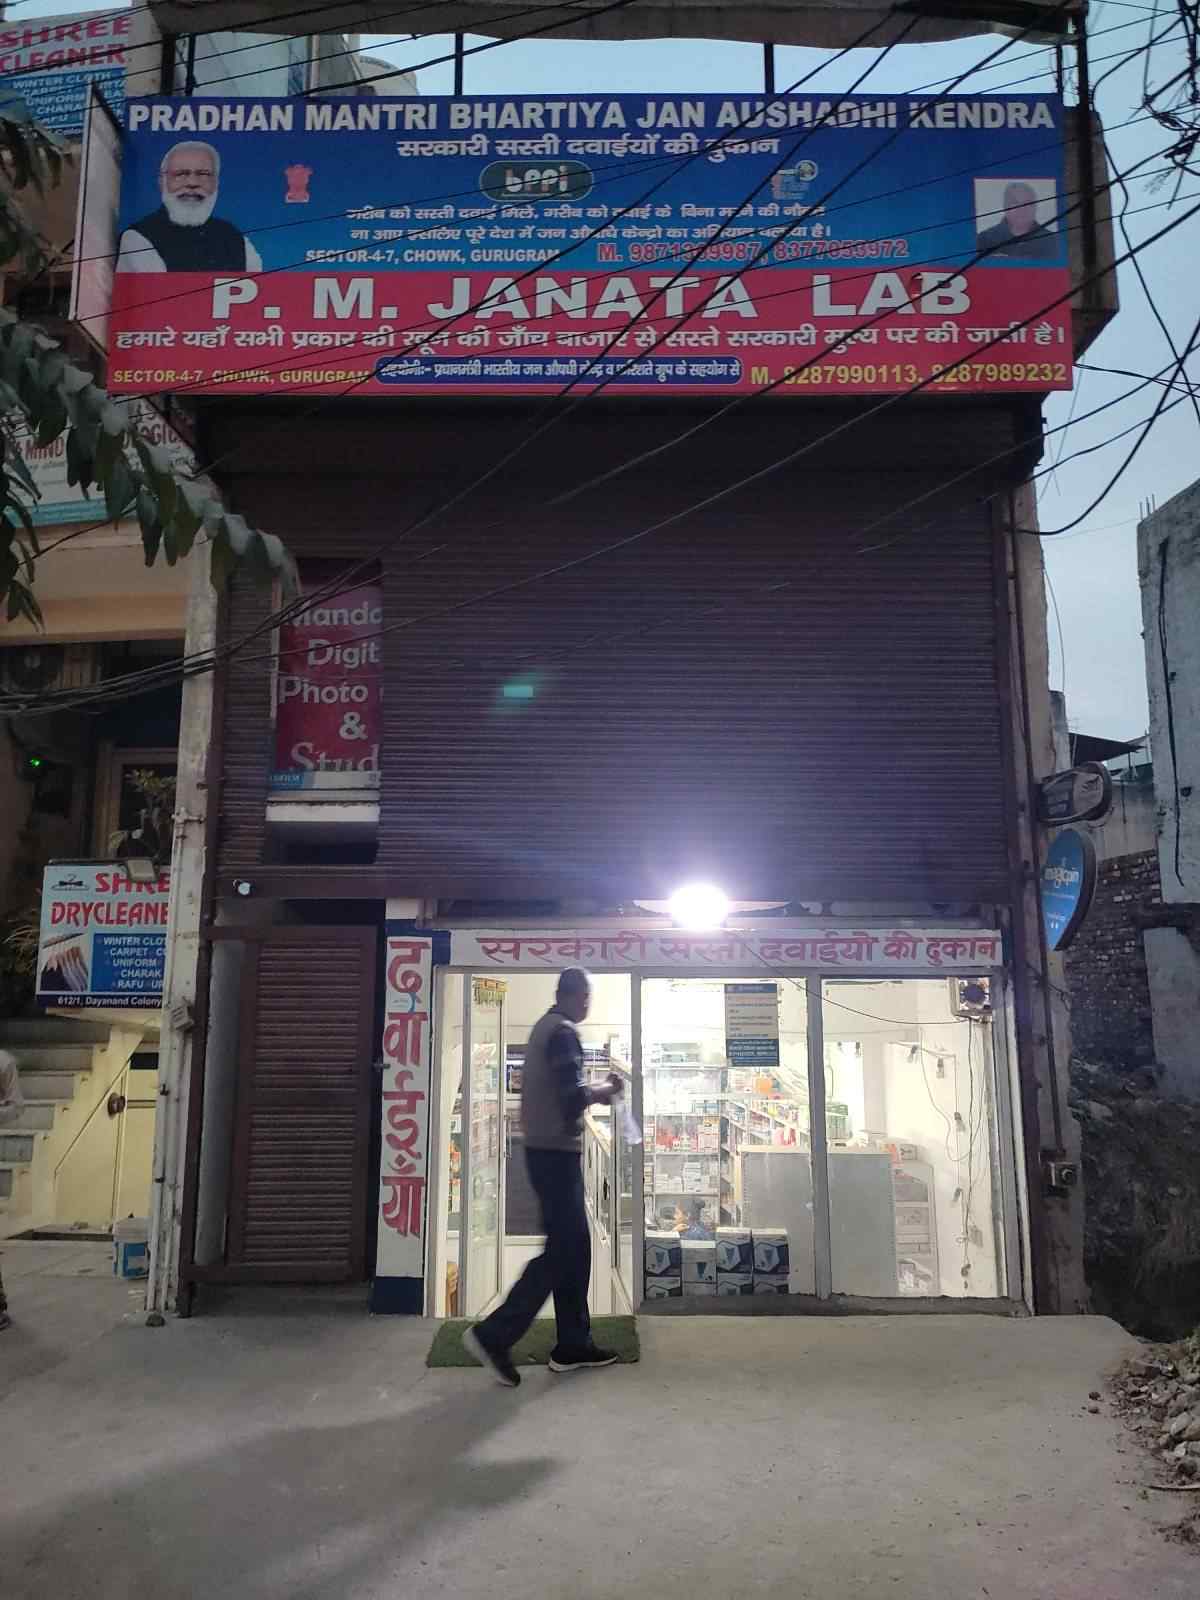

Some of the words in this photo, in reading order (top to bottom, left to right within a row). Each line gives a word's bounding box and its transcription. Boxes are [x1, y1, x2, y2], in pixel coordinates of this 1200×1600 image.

[129, 103, 293, 132] PRADHAN
[305, 102, 437, 131] MANTRI
[450, 102, 626, 129] BHARTIYA
[636, 101, 705, 129] JAN
[715, 101, 897, 129] AUSHADHI
[909, 101, 1056, 129] KENDRA
[397, 133, 490, 157] सरकारी
[496, 132, 561, 157] सस्ती
[663, 131, 699, 156] की
[704, 137, 780, 163] दुकान
[389, 205, 410, 219] को
[414, 204, 455, 220] सस्ती
[543, 204, 584, 219] गरीब
[587, 203, 608, 219] को
[655, 203, 673, 218] के
[679, 203, 716, 217] बिना
[757, 202, 780, 217] की
[465, 226, 486, 245] पूरे
[489, 226, 515, 240] देश
[517, 225, 535, 239] में
[537, 228, 566, 240] जन
[666, 226, 688, 239] का
[305, 248, 399, 266] SECTOR-4-7,
[404, 248, 467, 265] CHOWK,
[471, 248, 561, 264] GURUGRAM
[596, 241, 624, 262] M.
[212, 277, 281, 319] P.
[312, 277, 399, 319] M.
[427, 275, 758, 320] JANATA
[812, 271, 971, 317] LAB
[116, 326, 178, 349] हमारे
[182, 325, 232, 349] यहाँ
[233, 324, 286, 349] सभी
[291, 330, 358, 351] प्रकार
[362, 325, 398, 347] की
[456, 325, 494, 347] की
[496, 323, 550, 347] जाँच
[555, 328, 633, 348] बाजार
[634, 326, 658, 348] से
[663, 325, 721, 348] सस्ते
[726, 323, 819, 347] सरकारी
[886, 327, 921, 344] पर
[924, 320, 961, 344] की
[523, 363, 543, 376] जन
[750, 367, 776, 385] M.
[931, 364, 1067, 383] 8287989232
[279, 676, 369, 706] Photo
[338, 711, 369, 741] &
[104, 936, 141, 946] WINTER
[476, 930, 654, 964] सरकारी
[883, 930, 924, 962] की
[925, 936, 1001, 967] दुकान
[110, 948, 148, 957] CARPET
[112, 959, 157, 968] UNIFORM
